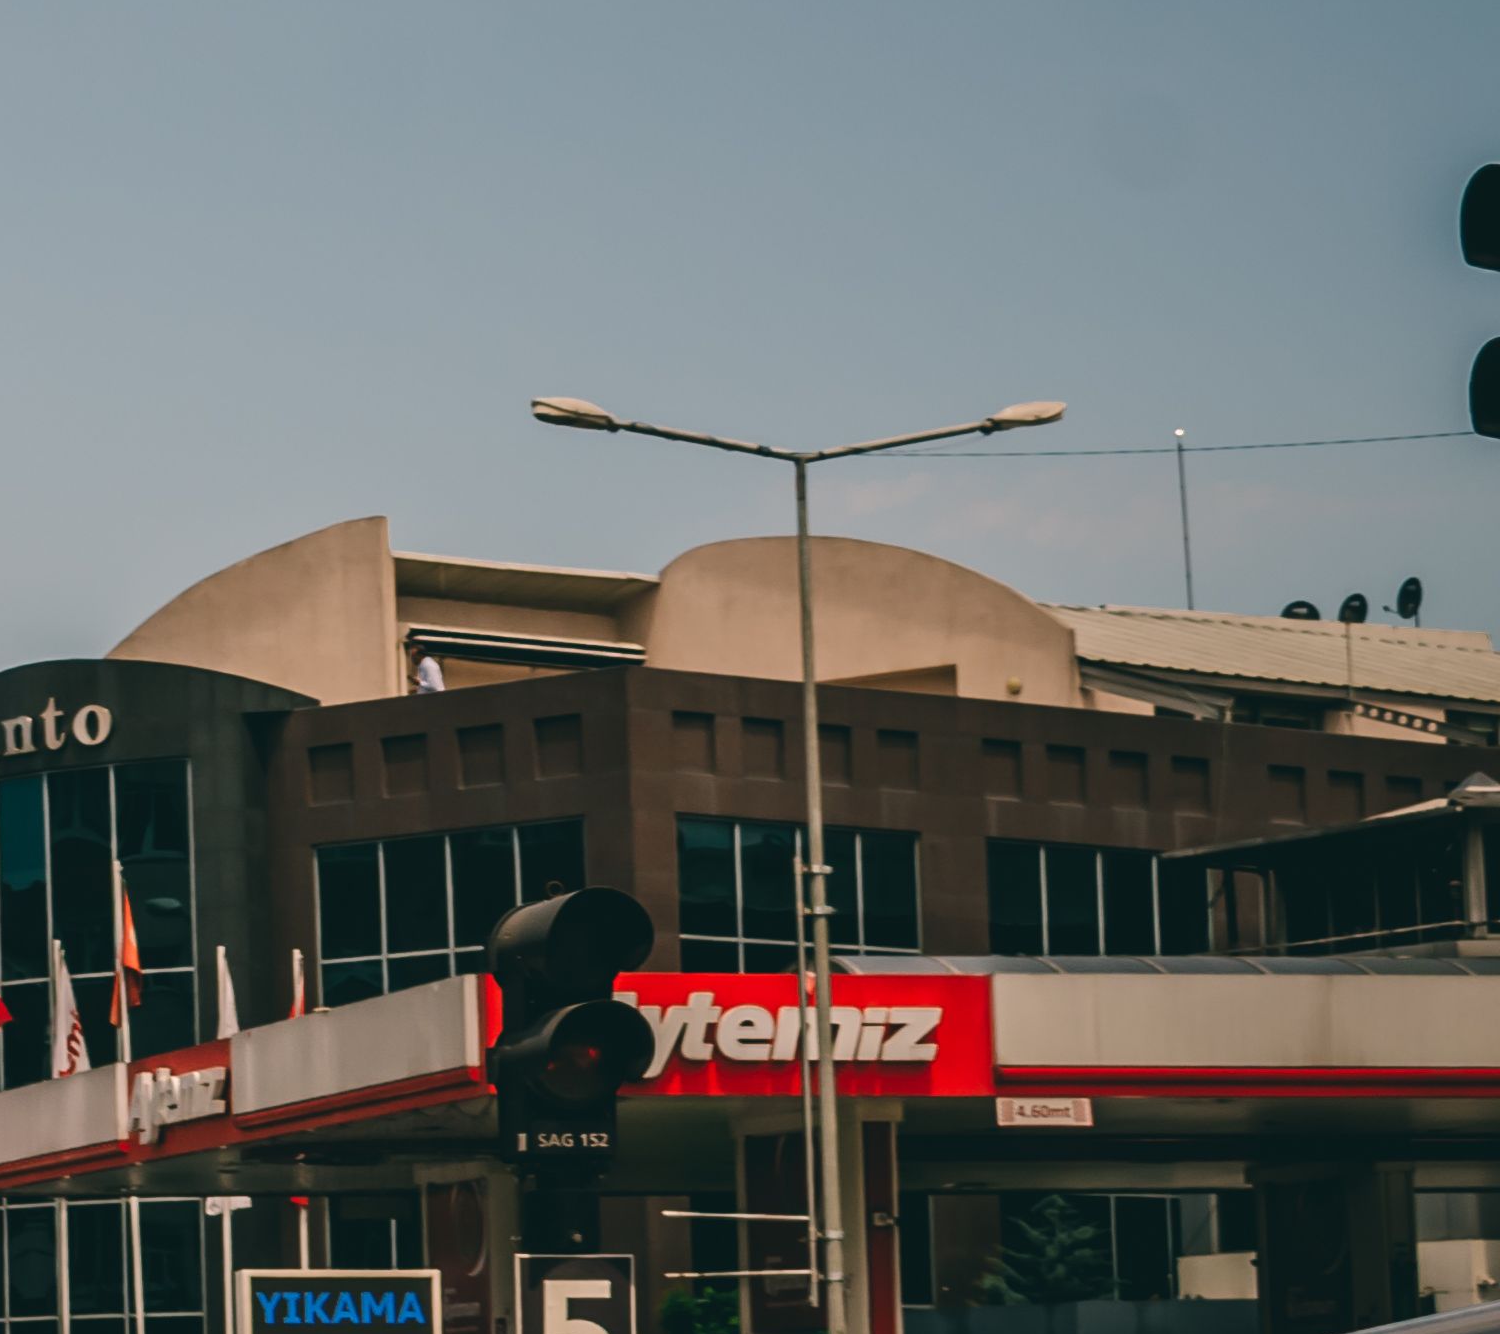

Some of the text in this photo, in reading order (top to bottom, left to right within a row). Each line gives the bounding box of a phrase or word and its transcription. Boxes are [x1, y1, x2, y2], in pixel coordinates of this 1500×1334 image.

[612, 991, 944, 1079] ytemiz
[580, 1132, 611, 1148] 152
[255, 1291, 427, 1324] YIKAMA
